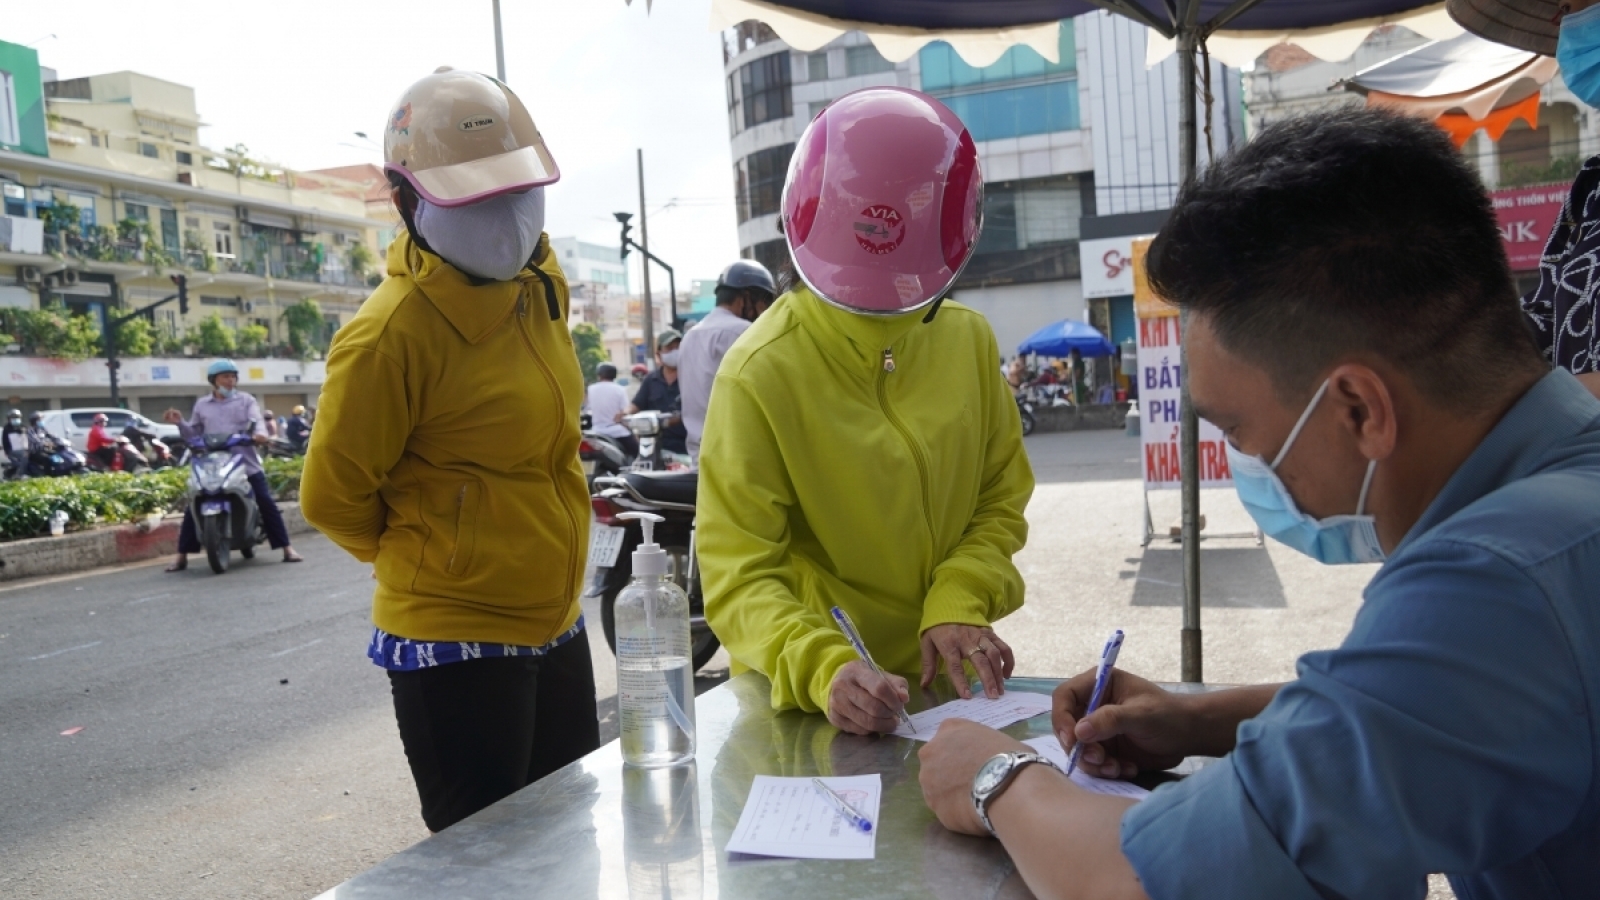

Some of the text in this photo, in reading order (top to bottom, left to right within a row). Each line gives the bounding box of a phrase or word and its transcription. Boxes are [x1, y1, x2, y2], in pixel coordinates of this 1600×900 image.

[870, 207, 899, 220] VIA
[1491, 197, 1513, 209] ÔNG
[1496, 220, 1540, 243] NK
[1140, 317, 1169, 347] KHI
[1149, 400, 1181, 423] PH
[1145, 425, 1233, 482] KHẨ TRA
